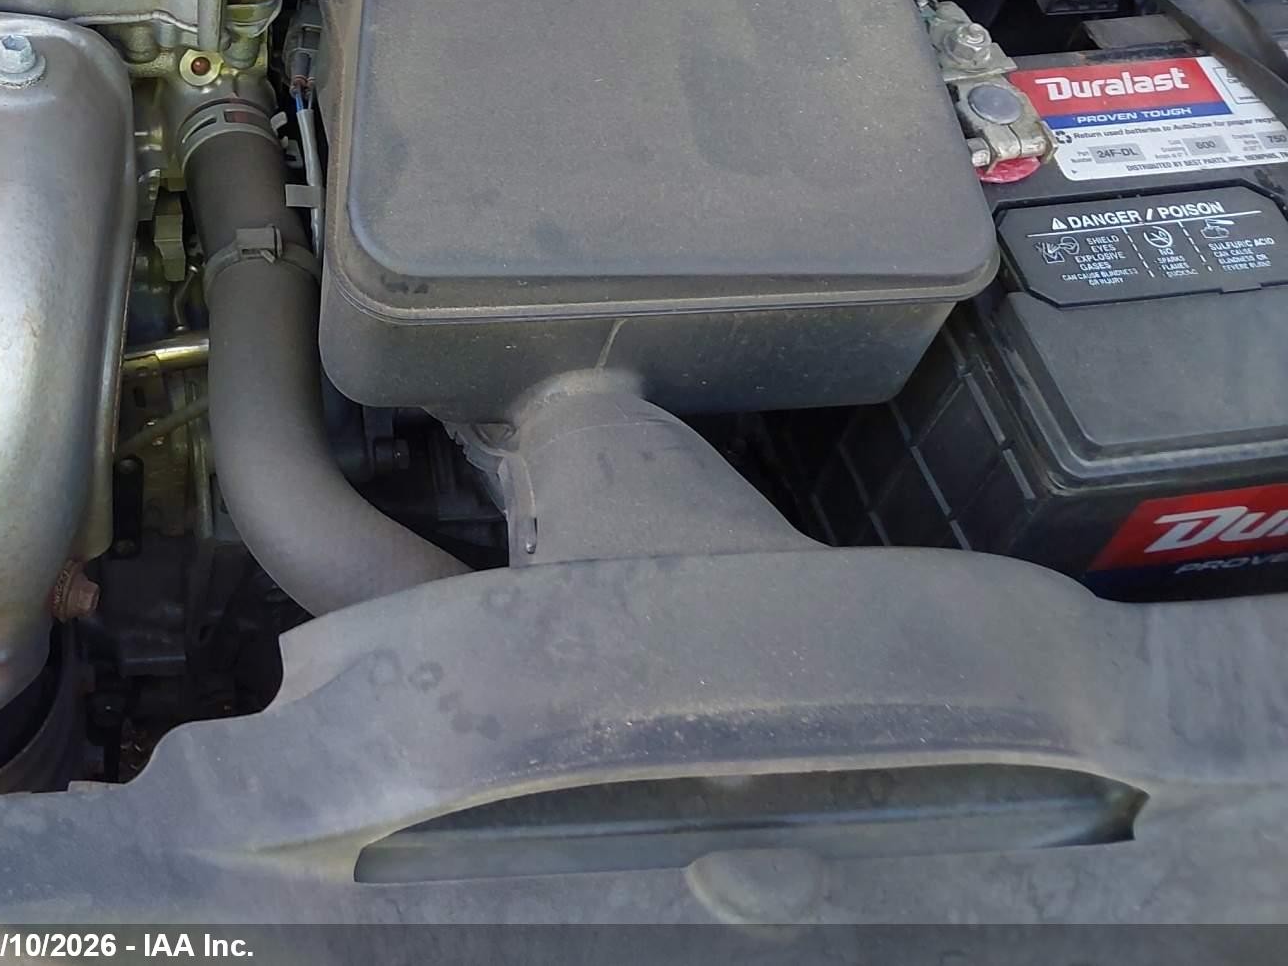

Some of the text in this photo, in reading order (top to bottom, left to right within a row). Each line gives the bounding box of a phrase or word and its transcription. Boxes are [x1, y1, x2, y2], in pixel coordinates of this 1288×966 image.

[1035, 68, 1190, 102] Duralast
[1077, 107, 1192, 124] PROVEN TOUGH
[1073, 131, 1101, 139] Return
[1104, 129, 1123, 137] used
[1125, 126, 1161, 134] batteries
[1173, 122, 1212, 130] AutoZone
[1097, 146, 1138, 159] 24F-DL
[1067, 210, 1142, 229] DANGER
[1157, 201, 1225, 219] POISON
[1086, 235, 1119, 245] SHIELD
[1208, 237, 1275, 251] SULFURIC ACID
[1091, 244, 1116, 253] EYES
[1158, 247, 1174, 255] NO
[1213, 250, 1229, 258] CAN
[1074, 252, 1126, 263] EXPLOSIVE
[1079, 261, 1112, 271] GASES
[1062, 273, 1078, 281] CAN
[1078, 271, 1100, 280] CAUSE
